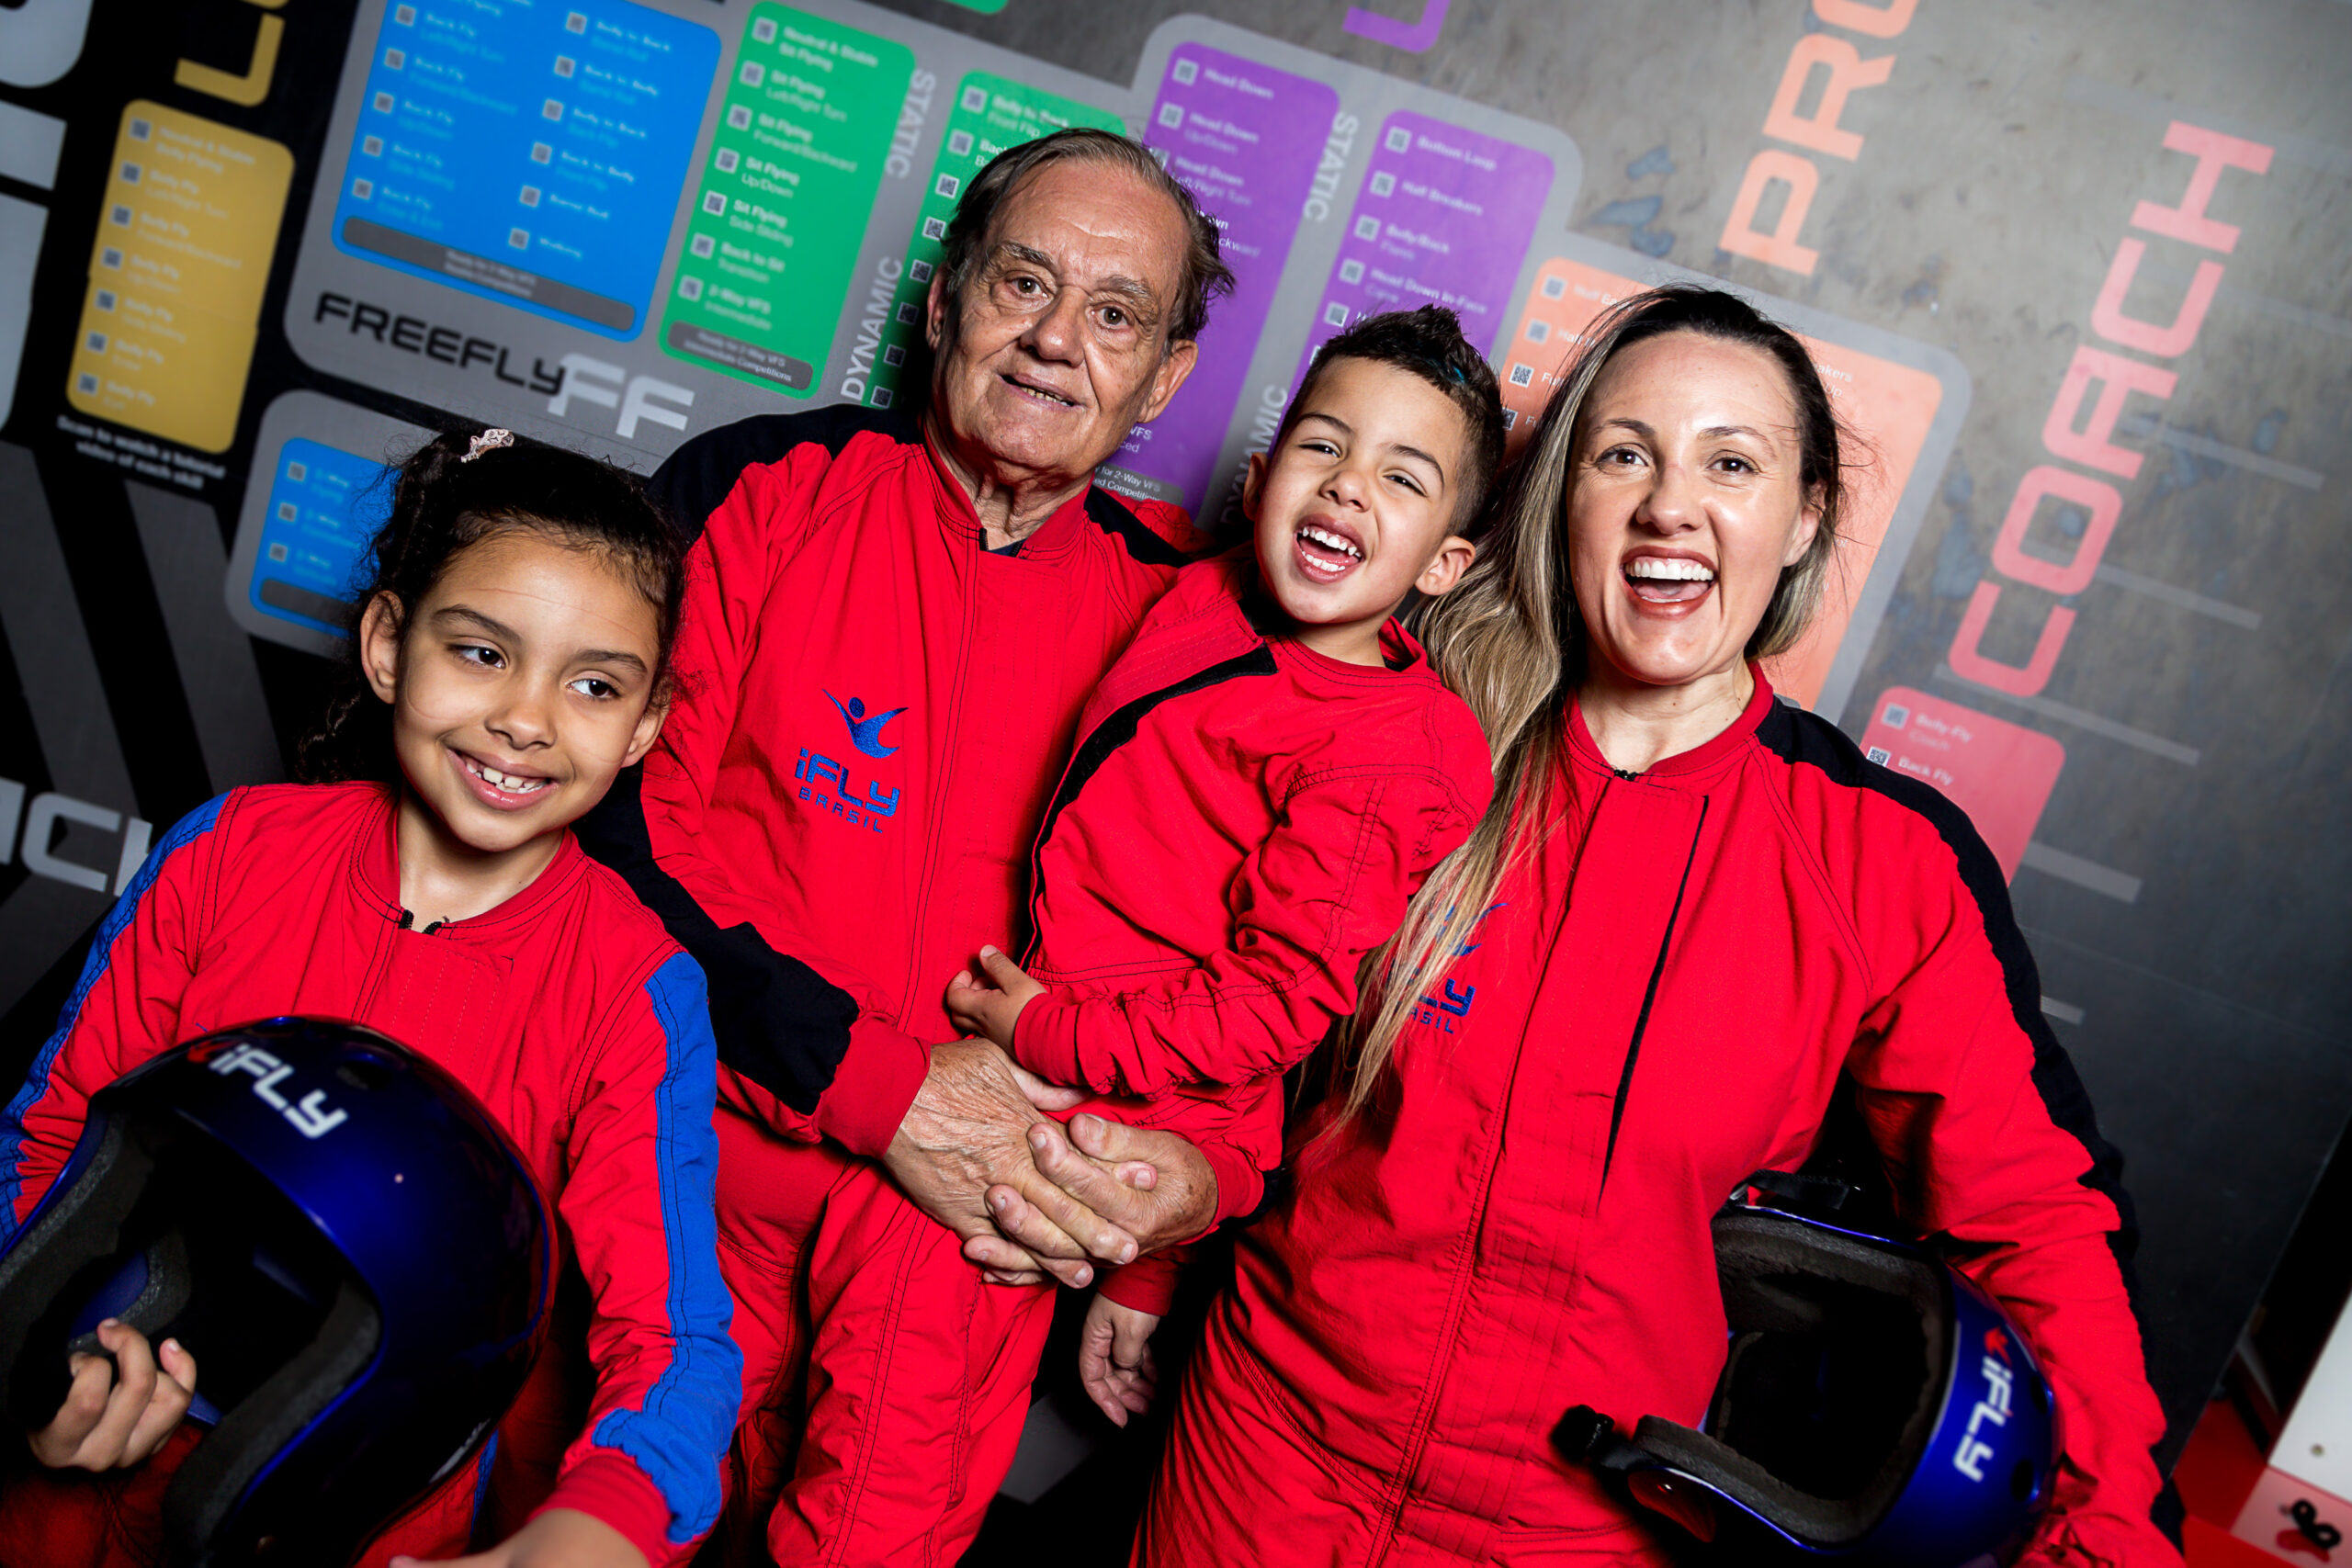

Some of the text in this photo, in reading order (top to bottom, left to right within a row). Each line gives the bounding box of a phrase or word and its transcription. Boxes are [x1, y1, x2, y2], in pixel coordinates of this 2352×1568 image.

[885, 68, 937, 179] STATIC
[1304, 109, 1359, 223] STATIC
[314, 290, 695, 440] FREEFLY FF
[841, 256, 903, 400] DYNAMIC
[1948, 119, 2276, 698] COACH
[1112, 469, 1143, 488] 2-Way
[798, 786, 883, 833] BRASIL
